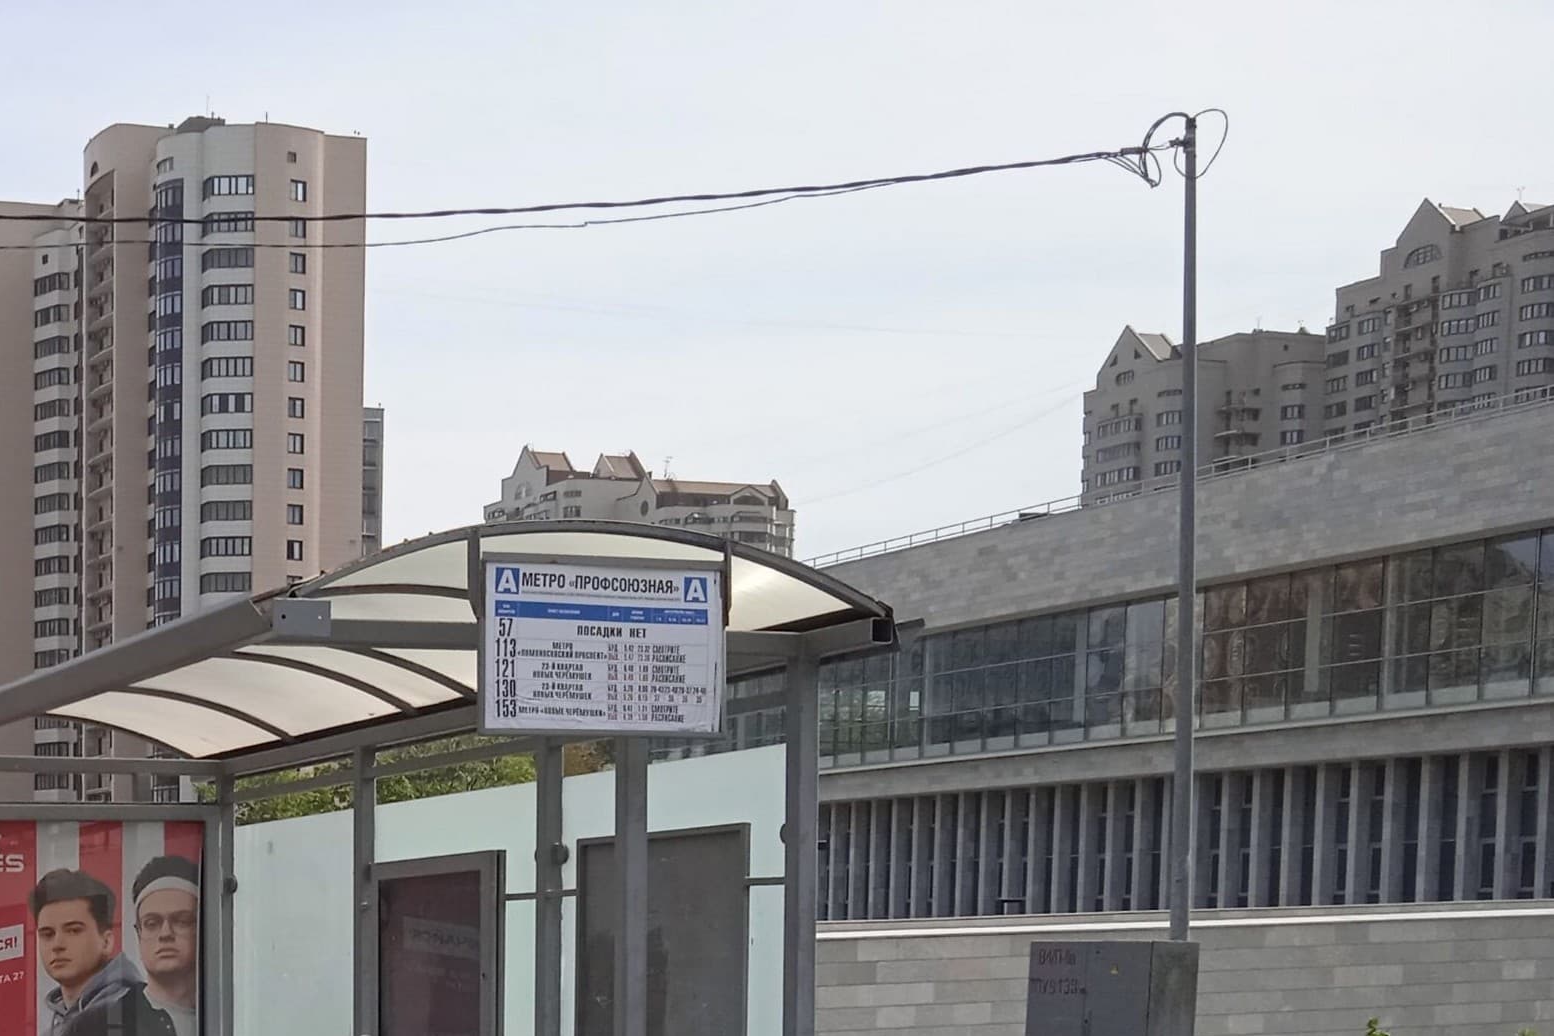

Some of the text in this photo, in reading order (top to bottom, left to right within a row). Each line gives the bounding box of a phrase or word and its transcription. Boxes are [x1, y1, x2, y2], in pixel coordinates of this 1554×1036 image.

[521, 572, 680, 594] МЕТРО «ПРОФСОЮЗНАЯ»
[498, 618, 513, 637] 57
[577, 625, 647, 639] ПОСАДКИ НЕТ
[495, 638, 517, 657] 113
[495, 659, 515, 678] 121
[495, 679, 516, 698] 130
[495, 699, 517, 718] 153
[12, 971, 24, 981] 2?
